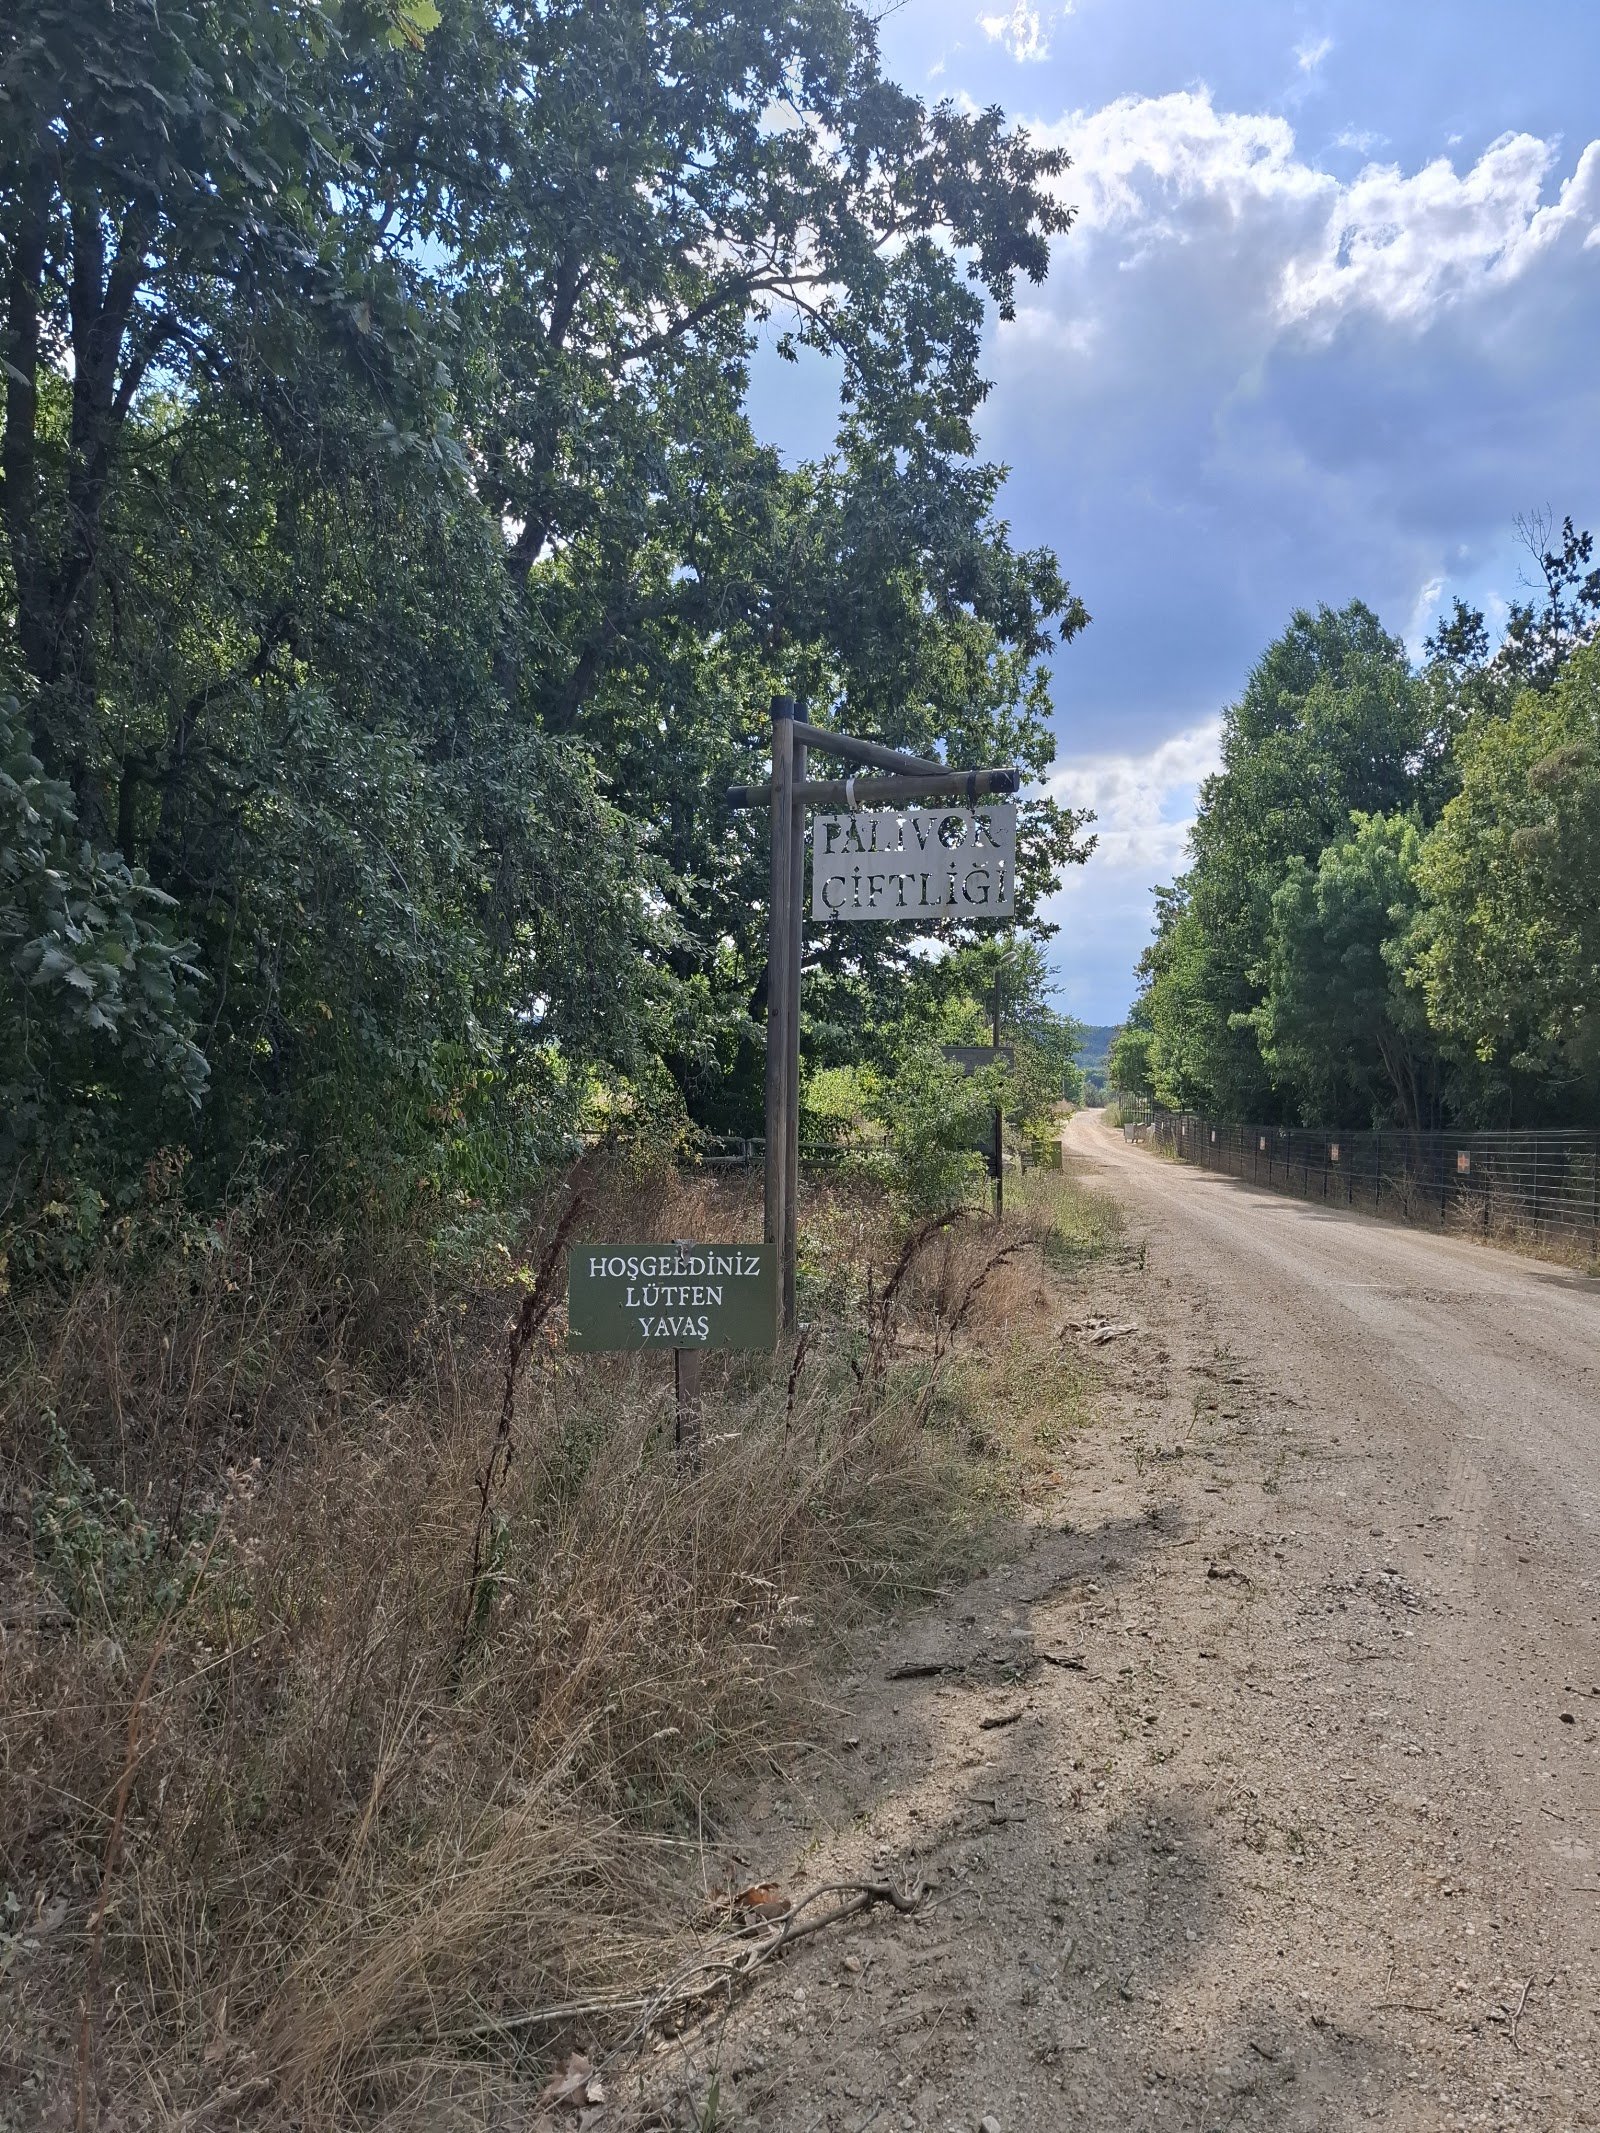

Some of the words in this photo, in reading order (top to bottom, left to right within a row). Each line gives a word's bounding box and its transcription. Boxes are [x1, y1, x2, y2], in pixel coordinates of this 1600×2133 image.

[821, 860, 1008, 920] ÇİFTLİĞİ
[589, 1251, 761, 1280] HOŞGELDİNİZ
[625, 1283, 724, 1307] LÜTFEN
[638, 1315, 710, 1341] YAVAŞ
